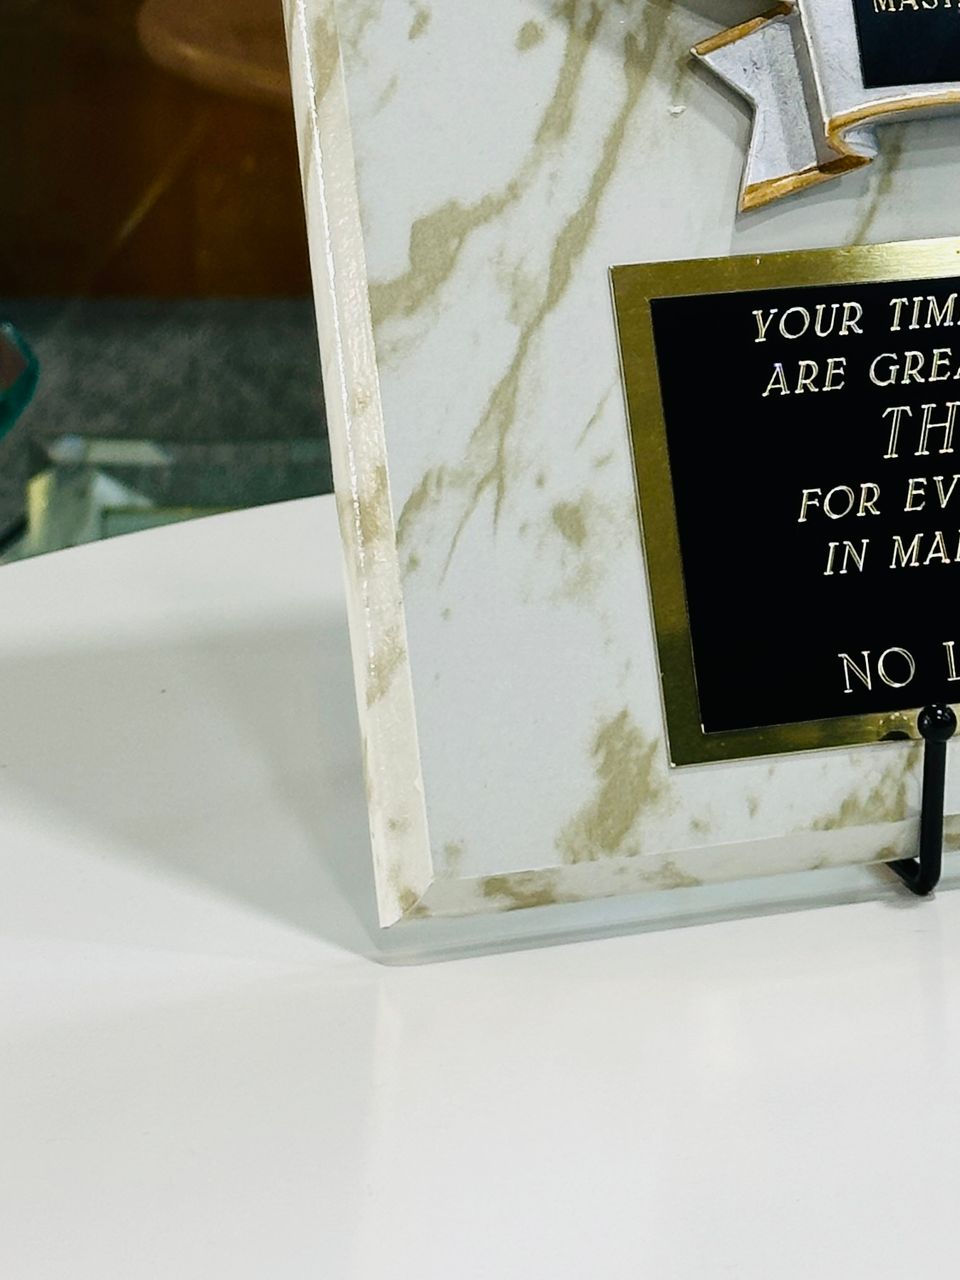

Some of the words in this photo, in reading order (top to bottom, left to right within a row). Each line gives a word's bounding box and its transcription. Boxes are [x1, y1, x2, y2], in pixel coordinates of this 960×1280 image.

[752, 300, 864, 343] YOUR
[762, 357, 847, 397] ARE
[798, 483, 880, 523] FOR
[823, 539, 869, 576] IN
[838, 647, 916, 694] NO
